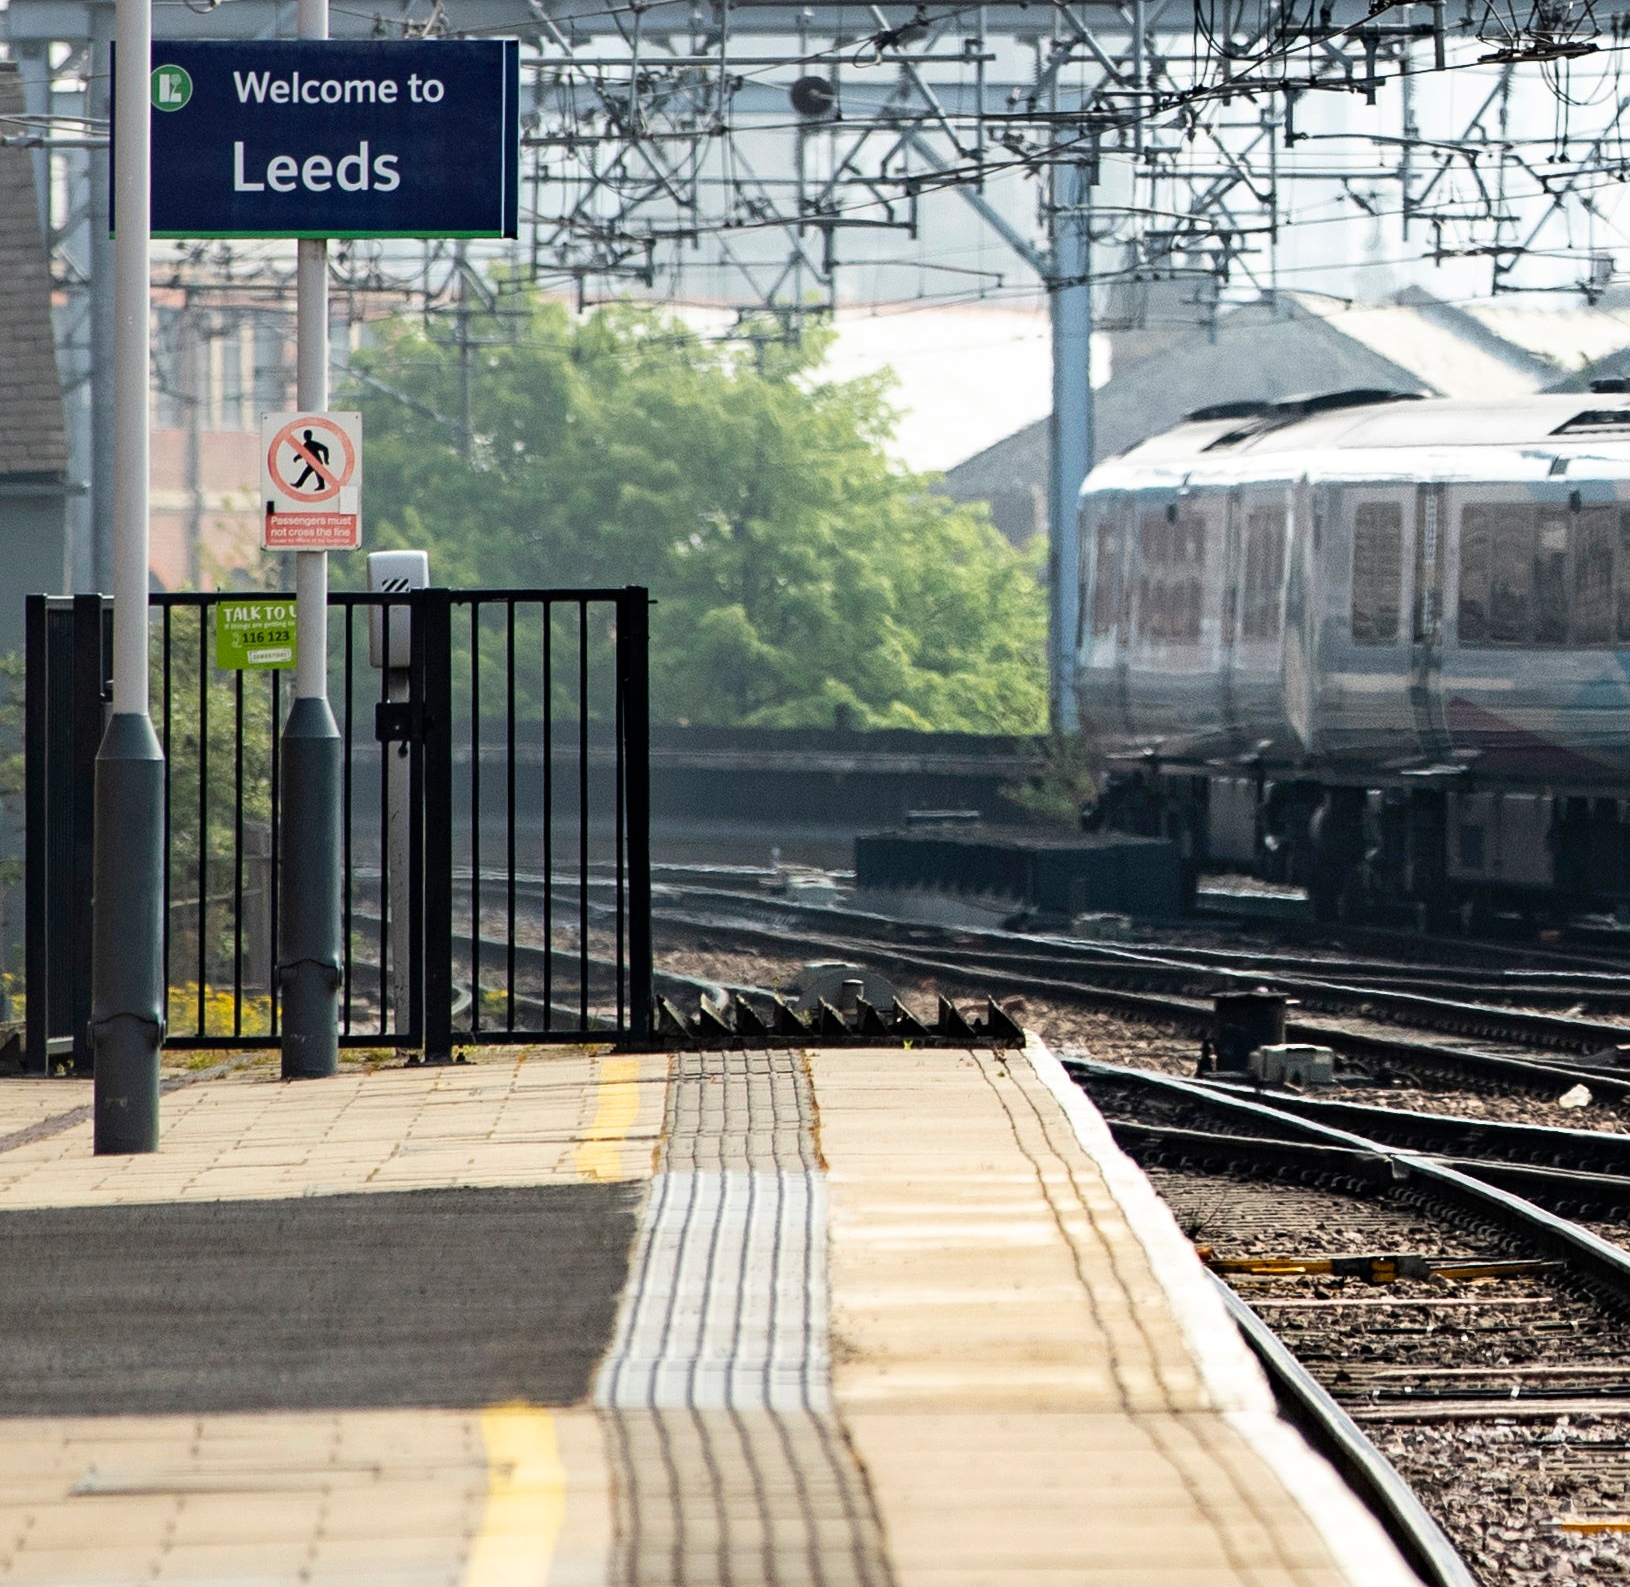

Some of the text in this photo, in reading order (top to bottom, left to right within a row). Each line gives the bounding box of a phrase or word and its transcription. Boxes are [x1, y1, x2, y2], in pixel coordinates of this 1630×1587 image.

[233, 71, 445, 104] Welcome to
[233, 140, 401, 193] Leeds
[271, 516, 352, 526] Passengers must
[271, 527, 350, 536] not cross the line
[222, 604, 297, 622] TALK TO U
[242, 631, 290, 643] 116 123
